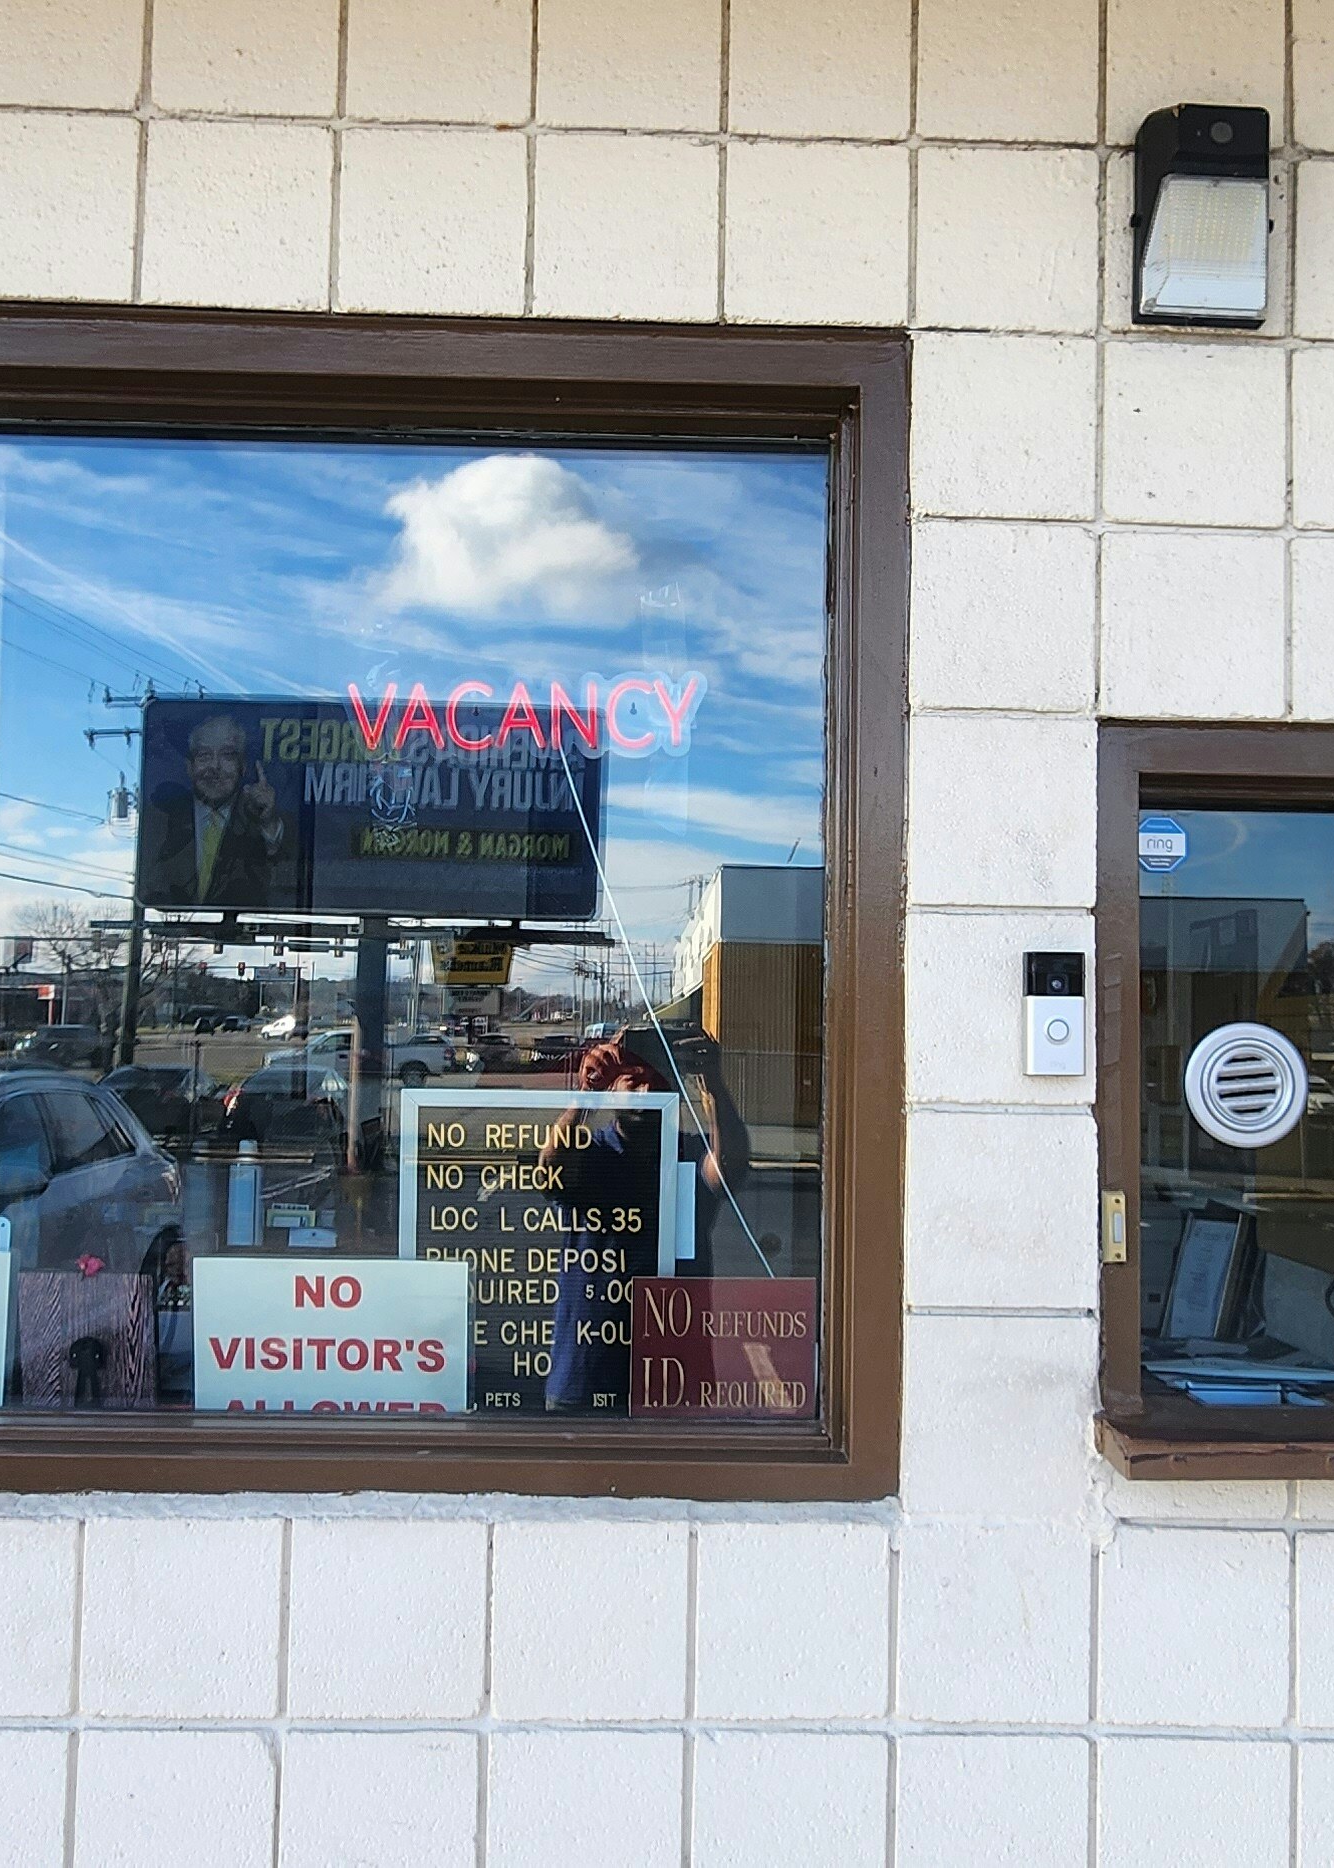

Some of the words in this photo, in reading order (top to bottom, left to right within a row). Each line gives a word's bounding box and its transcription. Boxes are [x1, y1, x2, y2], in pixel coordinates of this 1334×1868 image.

[347, 677, 698, 750] VACANCY
[1147, 837, 1173, 853] ring
[427, 1122, 465, 1148] NO
[485, 1124, 592, 1150] REFUND
[426, 1165, 463, 1190] NO
[480, 1165, 564, 1190] CHECK
[294, 1275, 362, 1309] NO
[469, 1279, 560, 1305] UIRED
[643, 1286, 692, 1338] NO
[701, 1310, 808, 1339] REFUNDS
[209, 1337, 446, 1373] VISITOR'S
[642, 1357, 690, 1408] I.D.
[700, 1381, 807, 1409] REQUIRED
[485, 1392, 521, 1407] PETS
